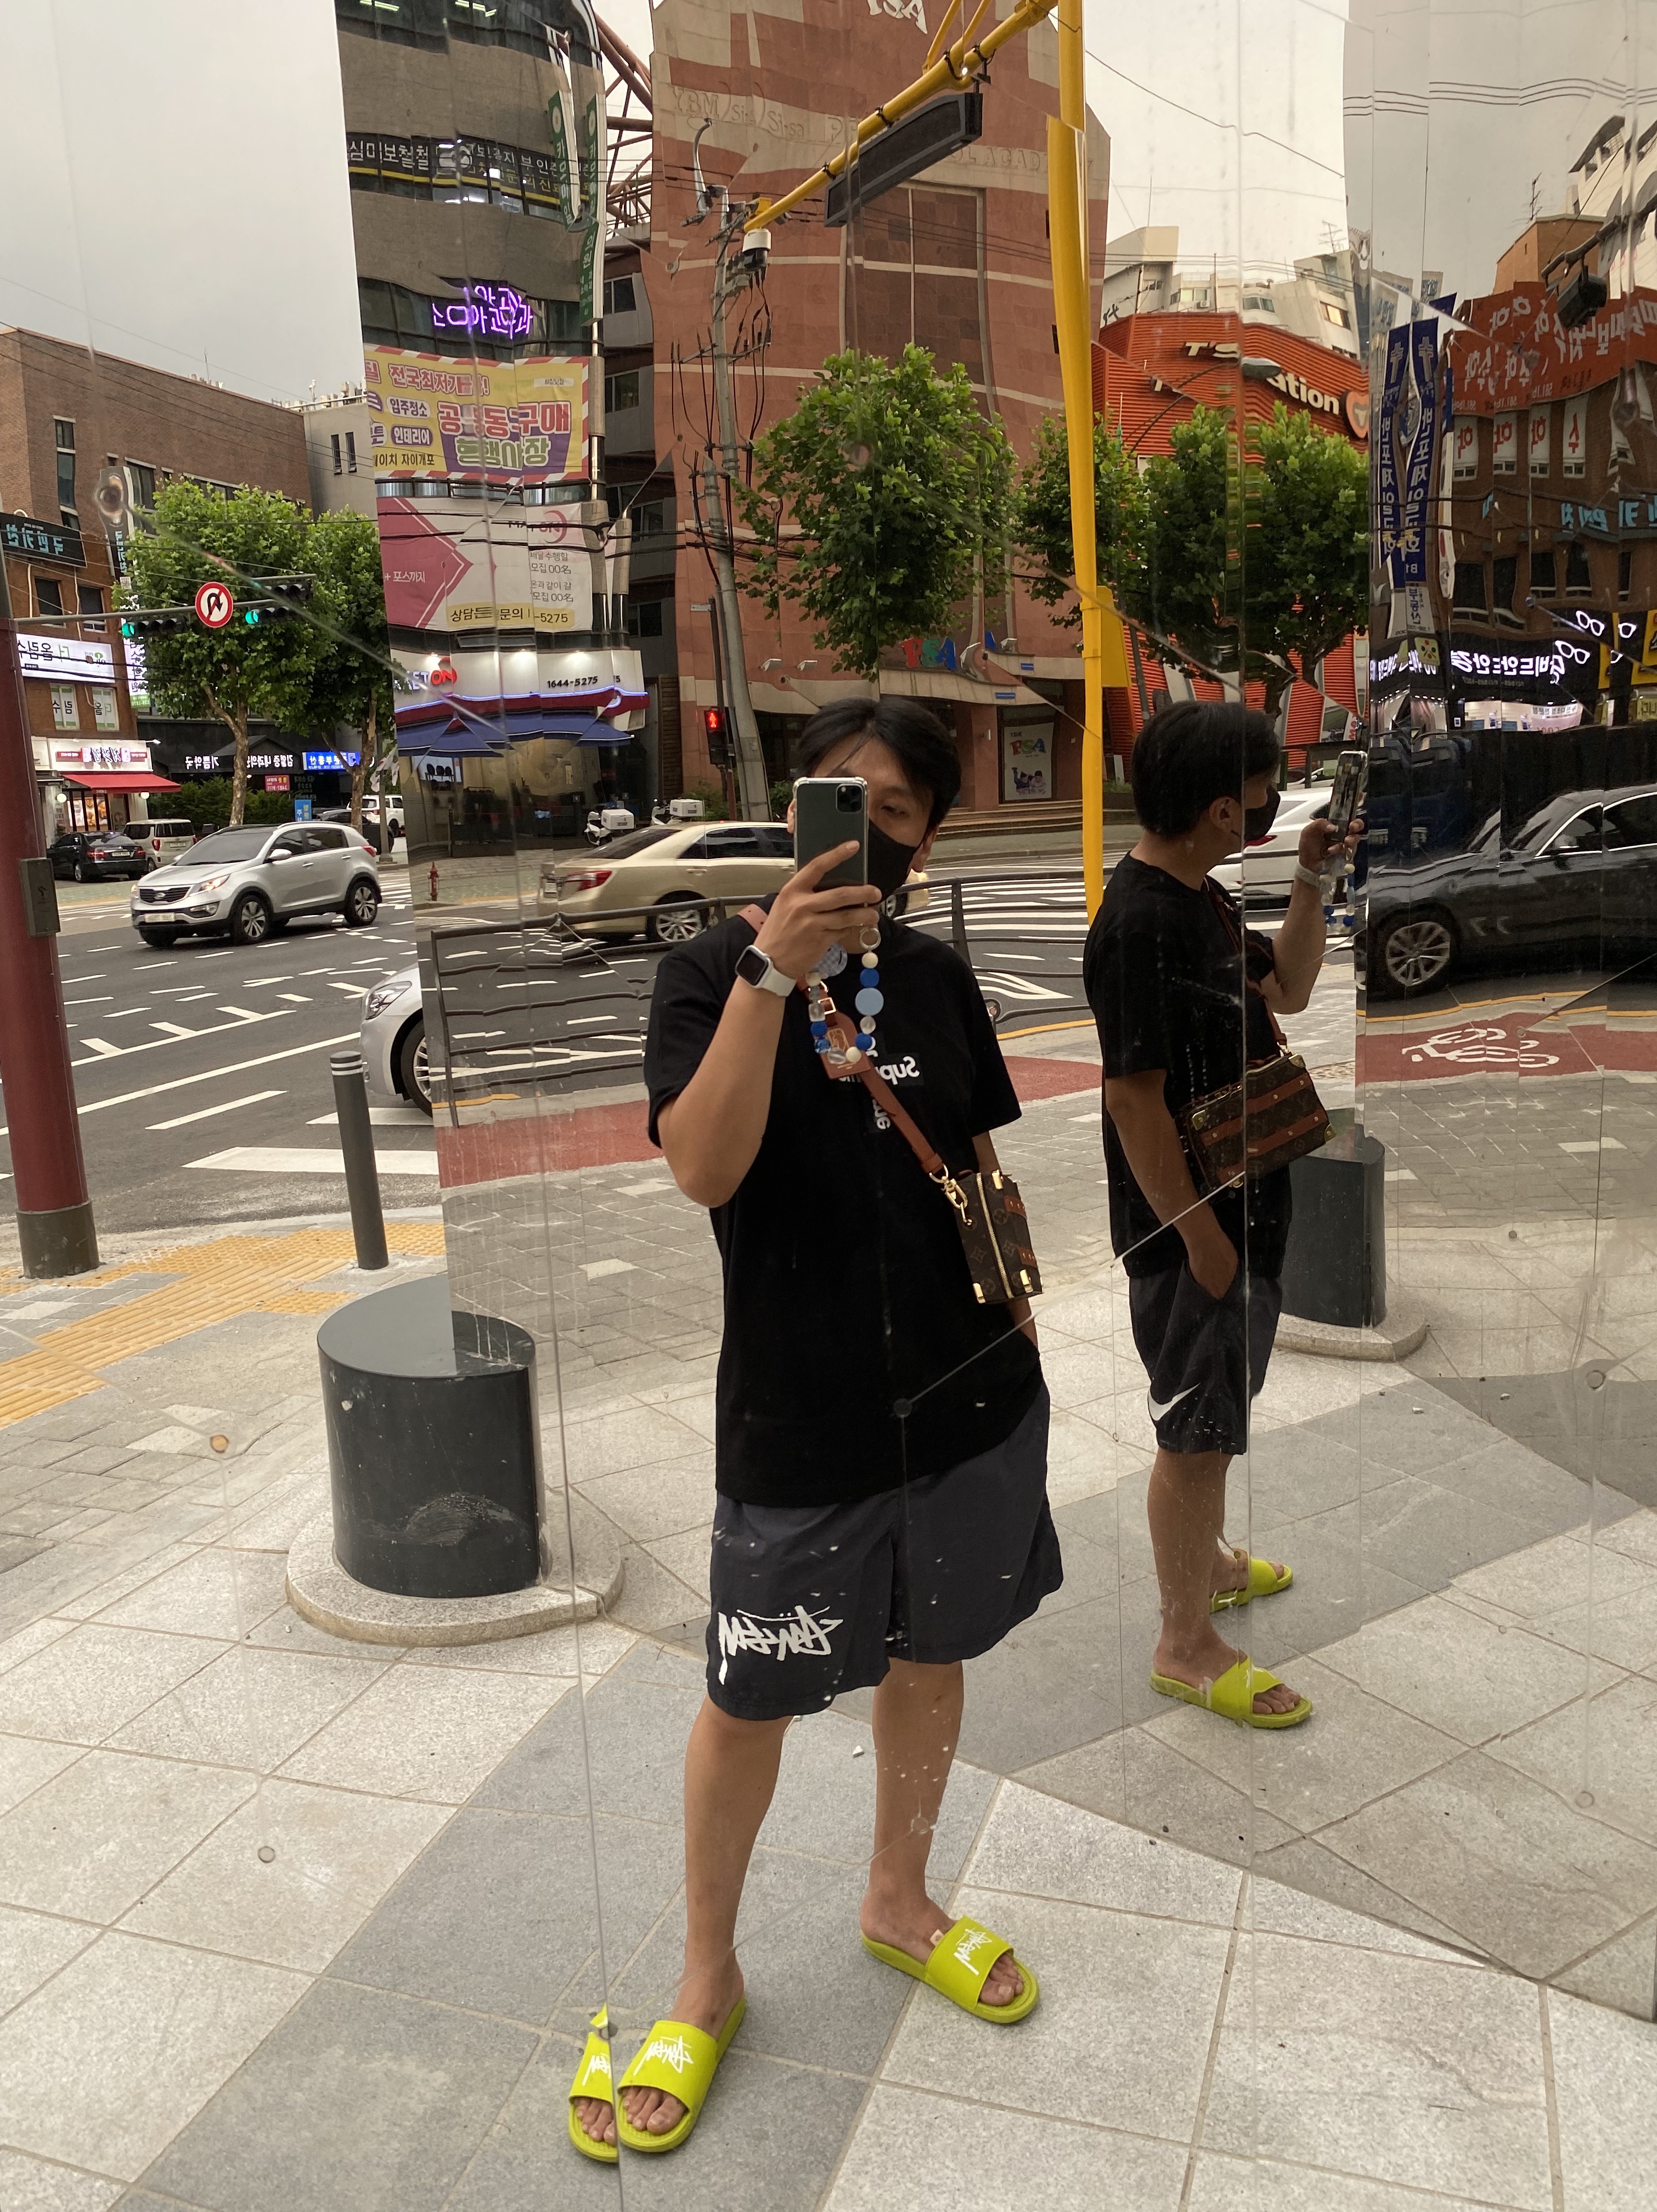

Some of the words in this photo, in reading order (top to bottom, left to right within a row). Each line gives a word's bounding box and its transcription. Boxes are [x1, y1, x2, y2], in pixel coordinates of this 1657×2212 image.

[672, 86, 719, 119] YBM
[390, 399, 427, 417] 입주청소
[394, 427, 430, 445] 인테리어
[402, 453, 435, 466] 자이개포
[531, 563, 546, 573] 모집
[393, 571, 425, 583] 포스까지
[533, 592, 549, 602] 모집
[901, 636, 957, 670] PSA
[547, 675, 598, 689] 1644-5275
[1010, 738, 1046, 755] PSA
